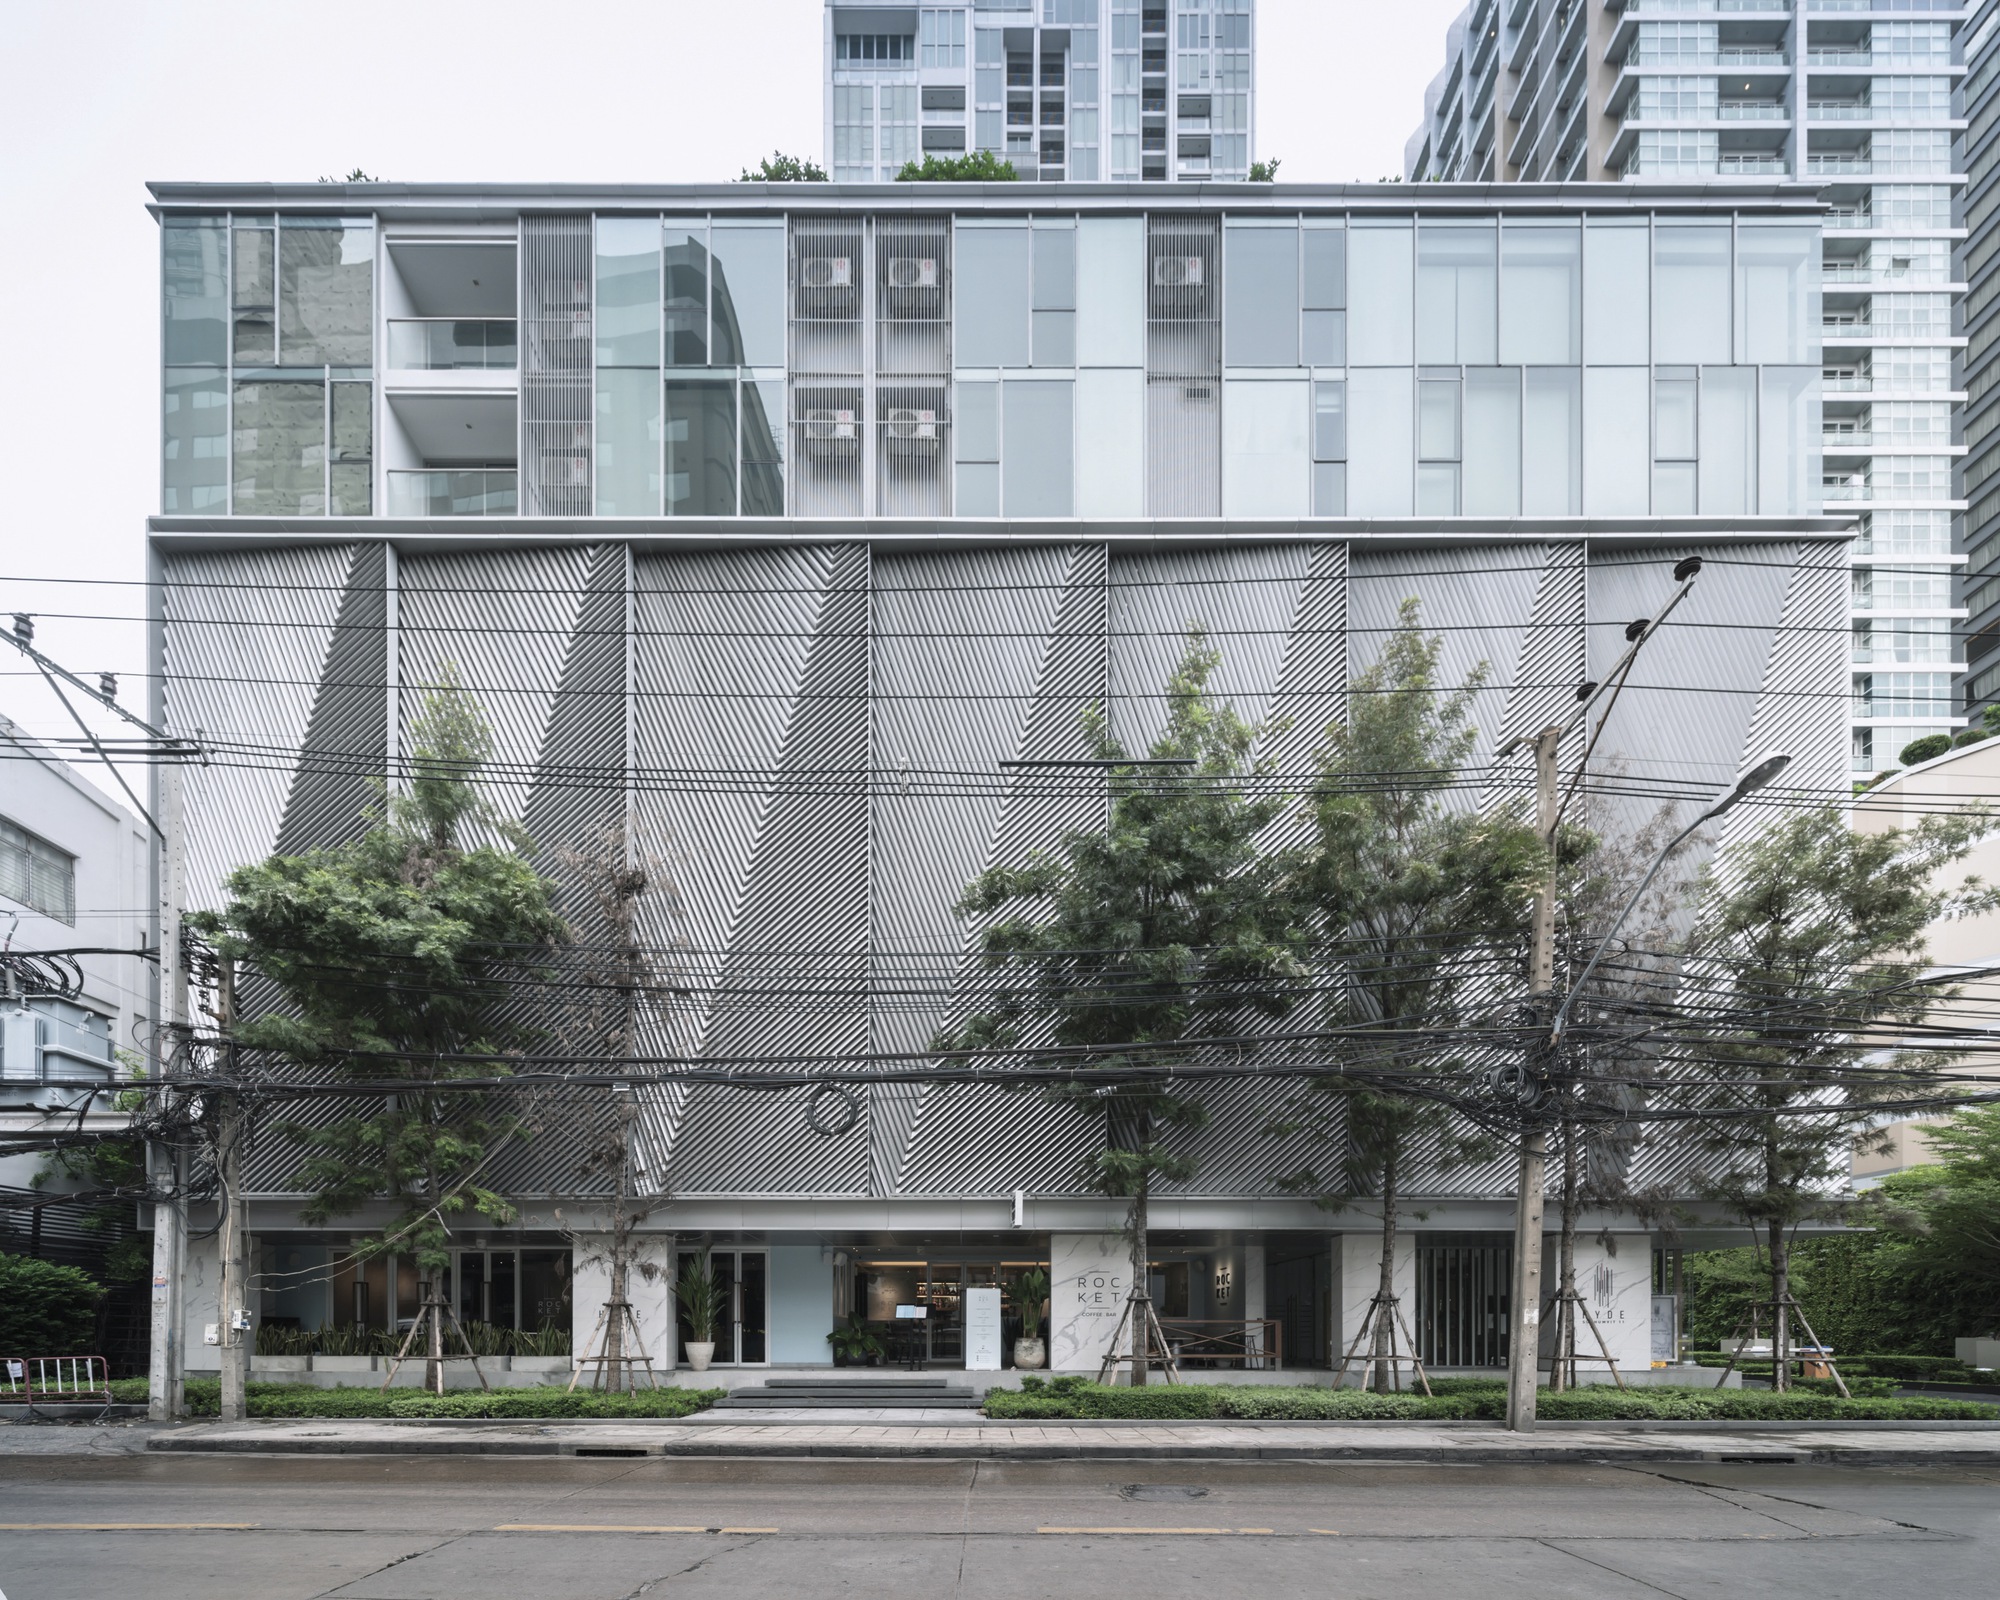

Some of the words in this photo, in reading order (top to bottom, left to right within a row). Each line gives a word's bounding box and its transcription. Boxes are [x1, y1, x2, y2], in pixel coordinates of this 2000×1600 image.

[1078, 1277, 1120, 1288] ROC
[1216, 1273, 1230, 1285] ROC
[1078, 1292, 1120, 1303] KET
[1216, 1286, 1230, 1299] KET
